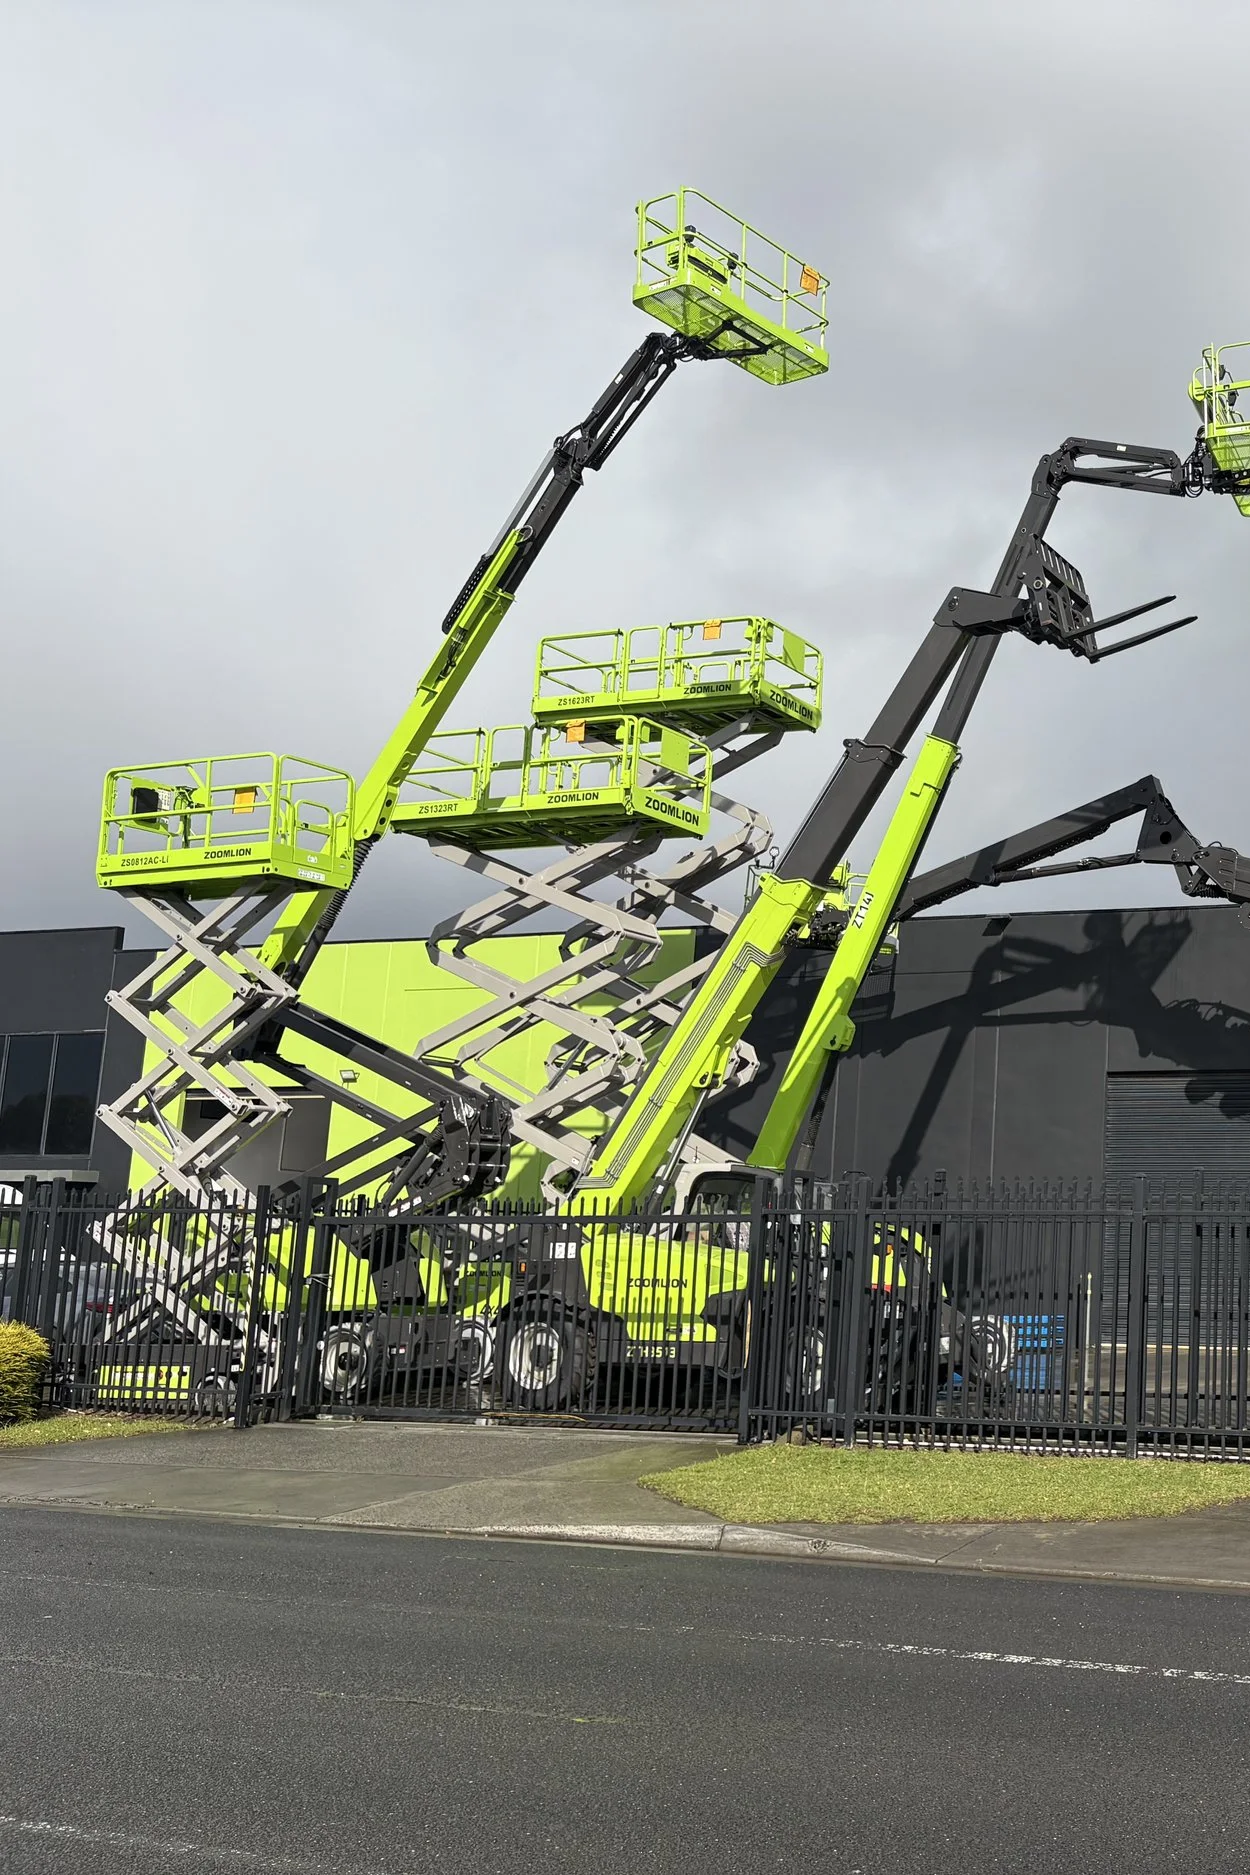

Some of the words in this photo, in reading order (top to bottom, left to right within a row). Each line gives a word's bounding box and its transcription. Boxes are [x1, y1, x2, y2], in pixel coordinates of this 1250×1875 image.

[683, 684, 732, 695] ZOOMLION
[557, 696, 595, 706] ZS1623RT
[769, 689, 814, 721] ZOOMLION
[547, 792, 599, 804] ZOOMLION
[419, 803, 458, 815] ZS1323RT
[645, 796, 700, 826] ZOOMLION
[204, 848, 252, 860] ZOOMLION
[852, 892, 874, 929] ZT14J
